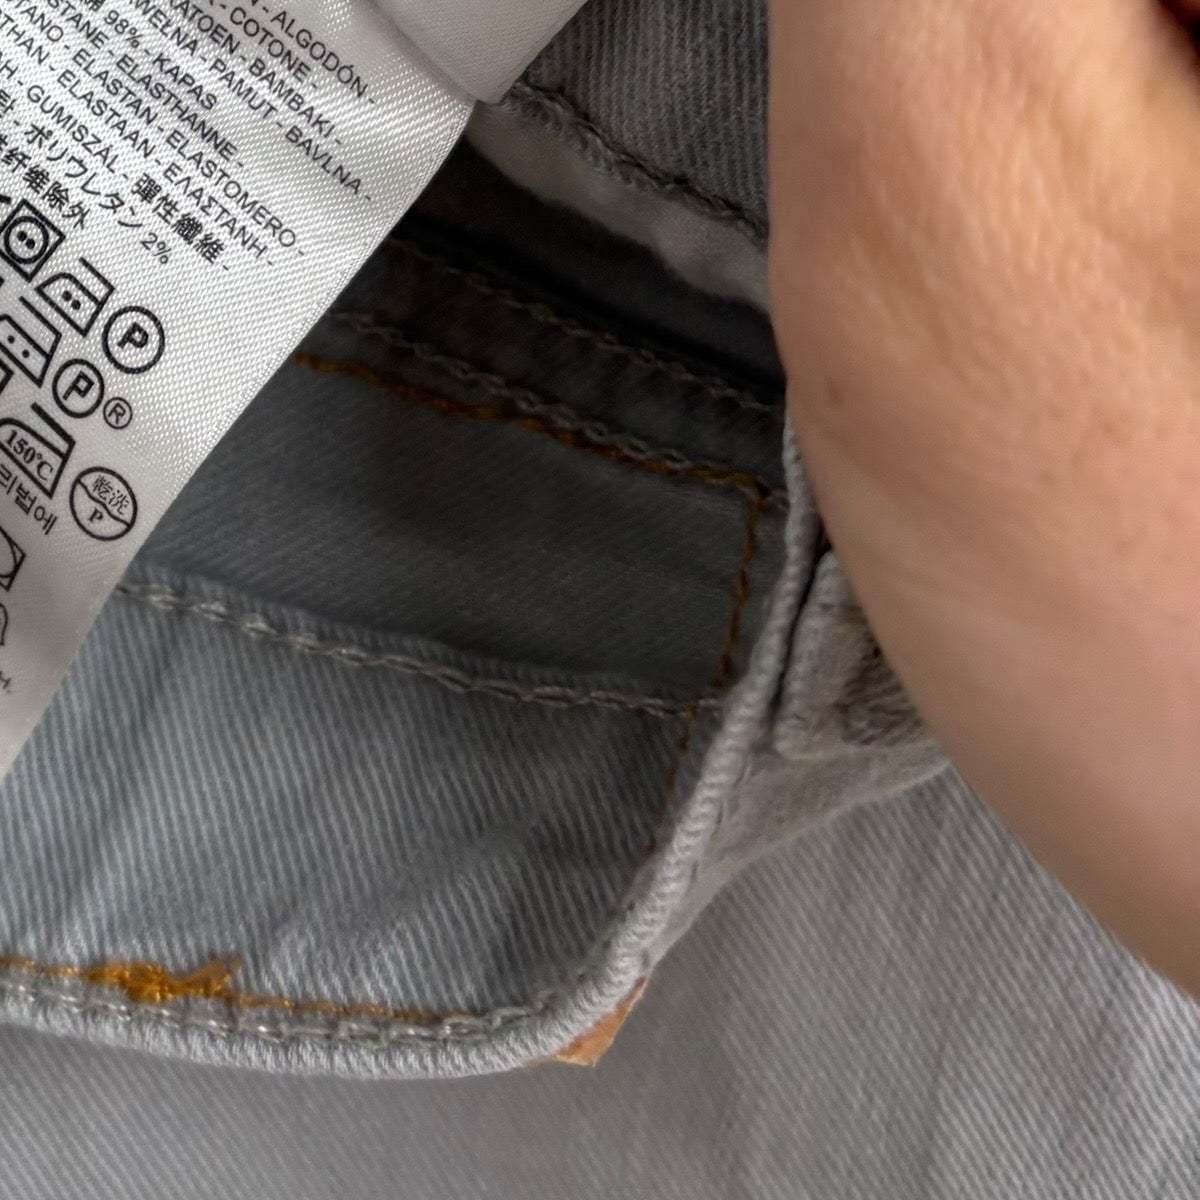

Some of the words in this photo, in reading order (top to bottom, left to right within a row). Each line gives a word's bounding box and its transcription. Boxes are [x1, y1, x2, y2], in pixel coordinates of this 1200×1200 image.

[104, 9, 141, 49] 98%
[229, 6, 312, 82] COTONE
[270, 10, 369, 98] ALGODÓN
[56, 68, 157, 160] ELASTAAN
[116, 54, 238, 164] ELASTHANNE
[152, 53, 217, 111] KAPAS
[209, 58, 279, 120] PAMUT
[285, 126, 363, 195] BAVLNA
[249, 58, 336, 139] BAMBAKI
[73, 48, 158, 126] ELASTAN
[166, 128, 297, 248] ELASTOMERO
[24, 123, 142, 228] ポリウレタン
[140, 232, 171, 265] 2%
